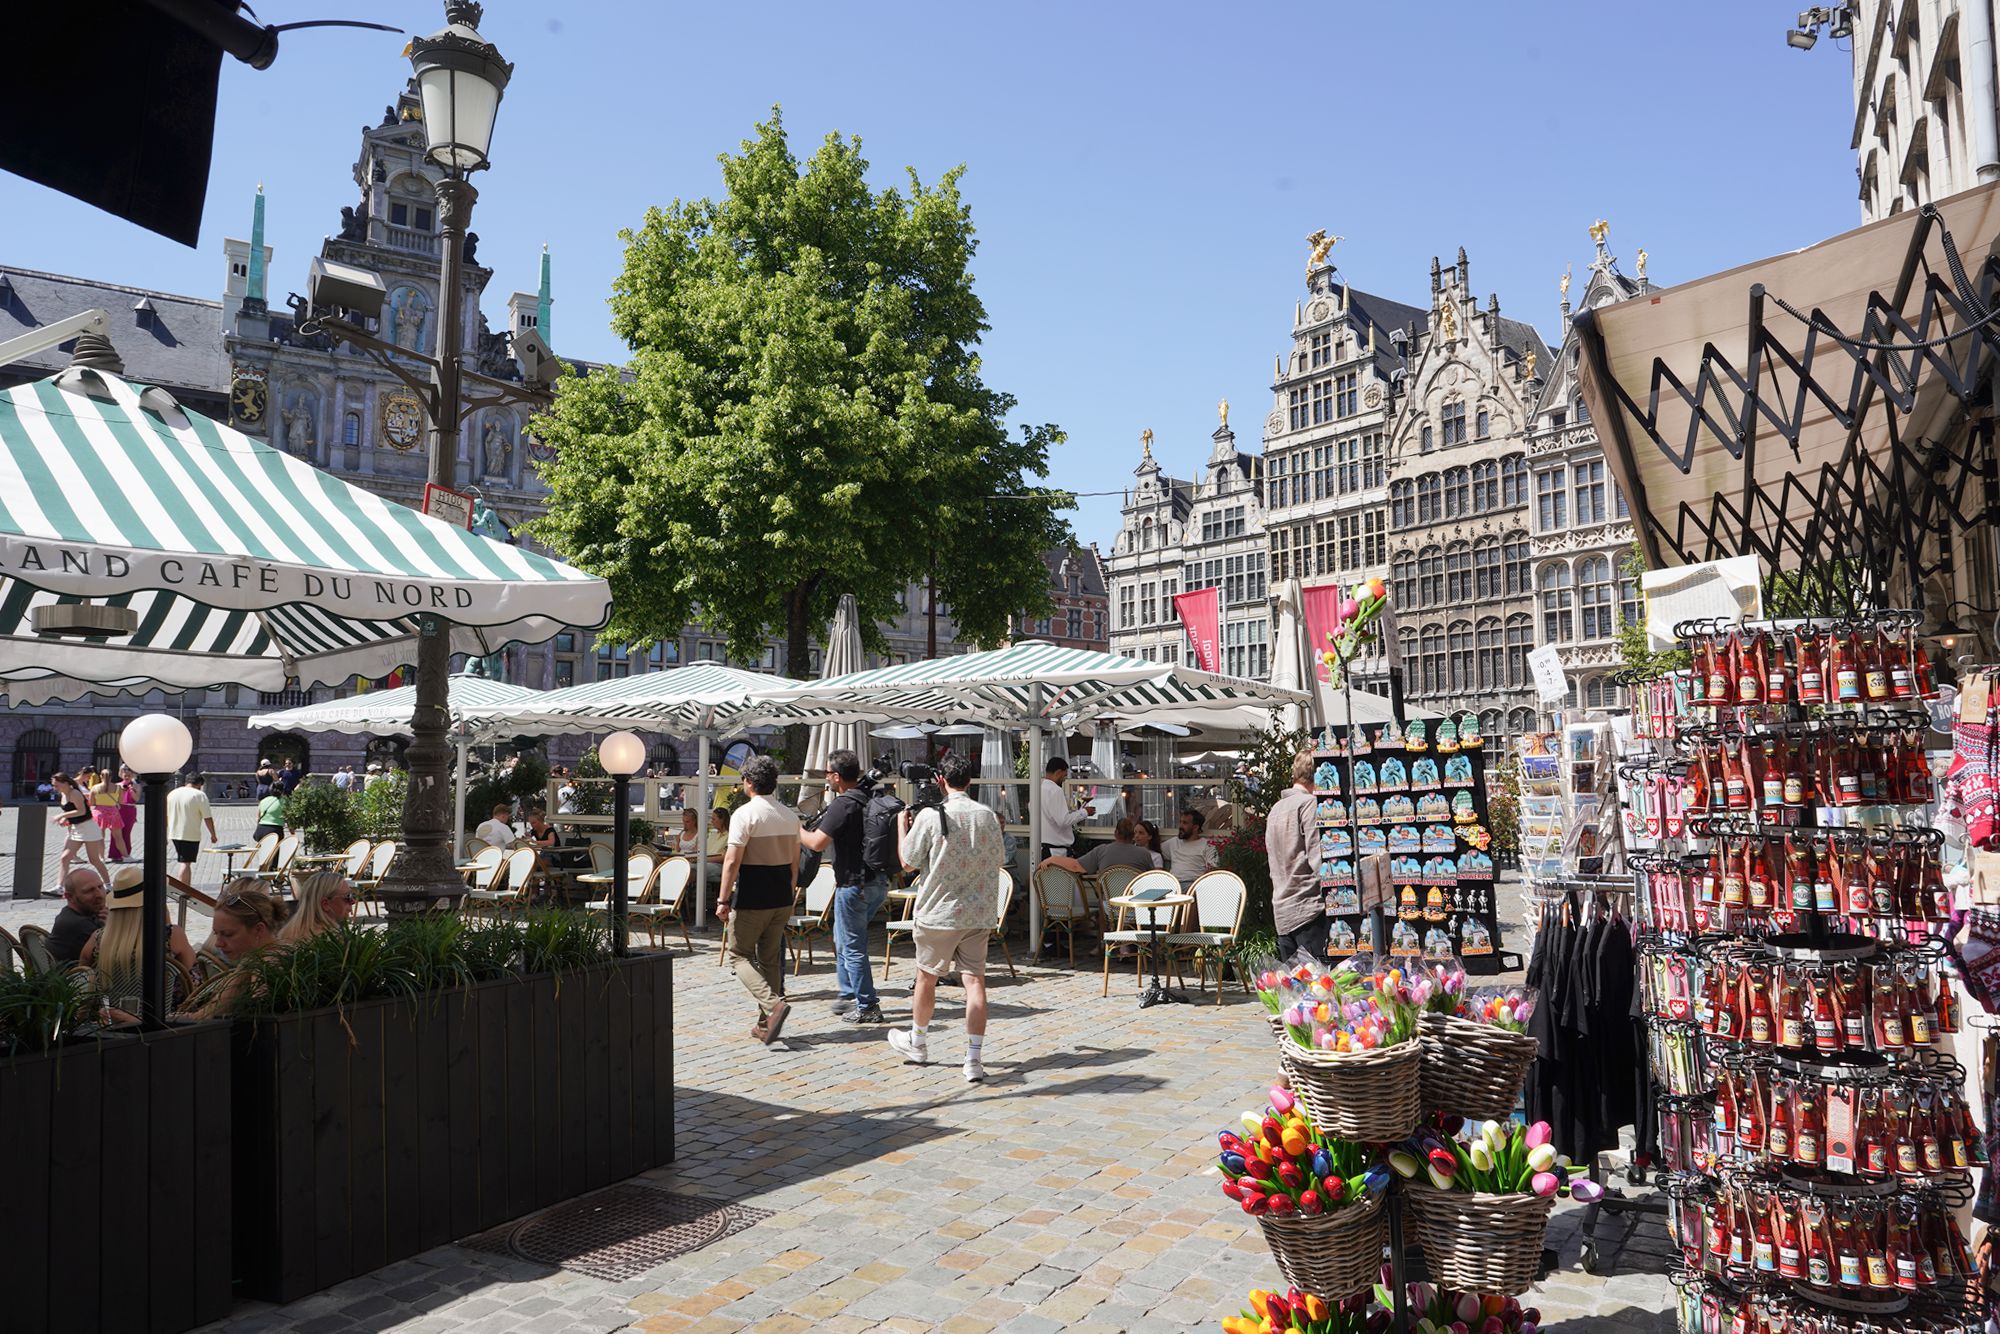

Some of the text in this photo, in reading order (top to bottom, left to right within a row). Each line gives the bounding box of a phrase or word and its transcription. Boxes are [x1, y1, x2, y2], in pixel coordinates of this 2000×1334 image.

[437, 491, 463, 507] H100
[0, 544, 474, 609] AND CAFÉ DU NORD
[1936, 704, 1953, 720] HO
[1321, 879, 1353, 887] ANTWERPEN
